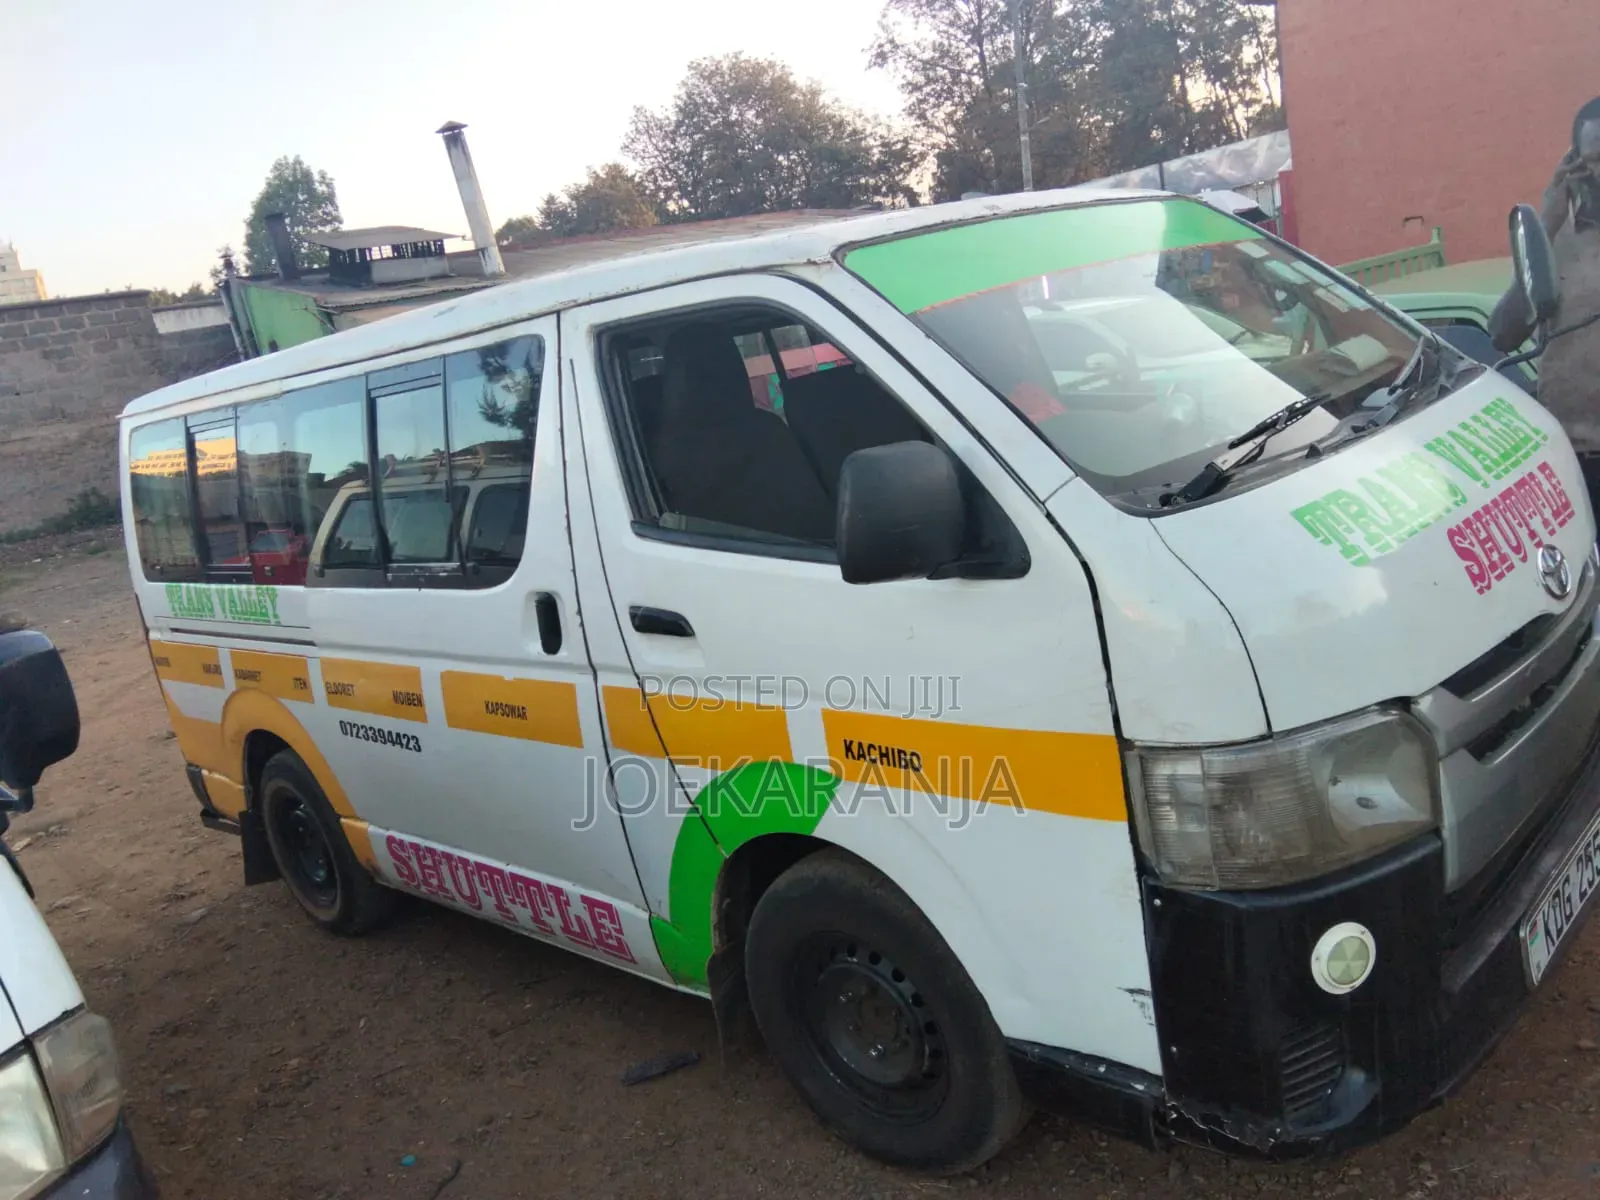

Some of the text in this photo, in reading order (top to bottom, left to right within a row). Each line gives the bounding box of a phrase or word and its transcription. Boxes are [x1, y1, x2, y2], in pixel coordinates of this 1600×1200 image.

[1290, 397, 1549, 567] TRANS VALLEY
[1447, 461, 1576, 595] SHUTTLE
[165, 583, 281, 625] TRANS VALLEY
[325, 681, 355, 697] ELDORET
[392, 690, 423, 708] MOIBEN
[484, 700, 528, 721] KAPSOWAR
[339, 719, 423, 753] 0723394423
[843, 738, 922, 773] KACHIBO
[386, 834, 638, 965] SHUTTLE
[1542, 873, 1574, 957] KDG
